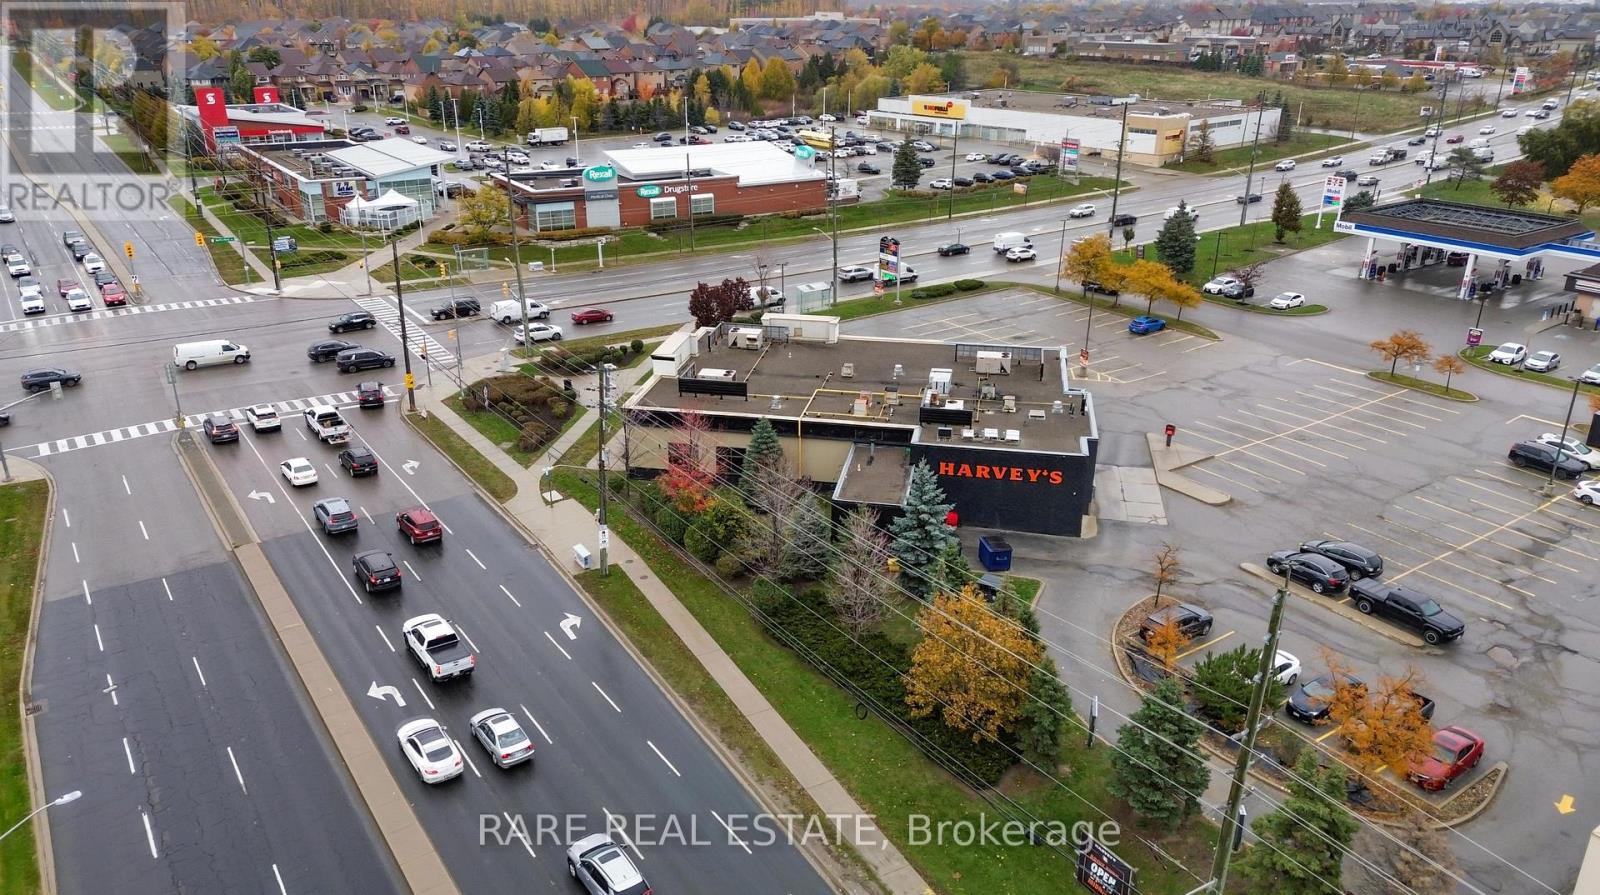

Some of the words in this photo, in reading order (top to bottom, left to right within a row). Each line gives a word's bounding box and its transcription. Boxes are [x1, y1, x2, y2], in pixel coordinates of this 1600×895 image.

[590, 170, 613, 179] Rexall
[640, 188, 660, 196] Rexall
[1336, 222, 1353, 230] Mobil
[939, 461, 1063, 484] HARVEY'S
[1090, 862, 1117, 886] OPEN
